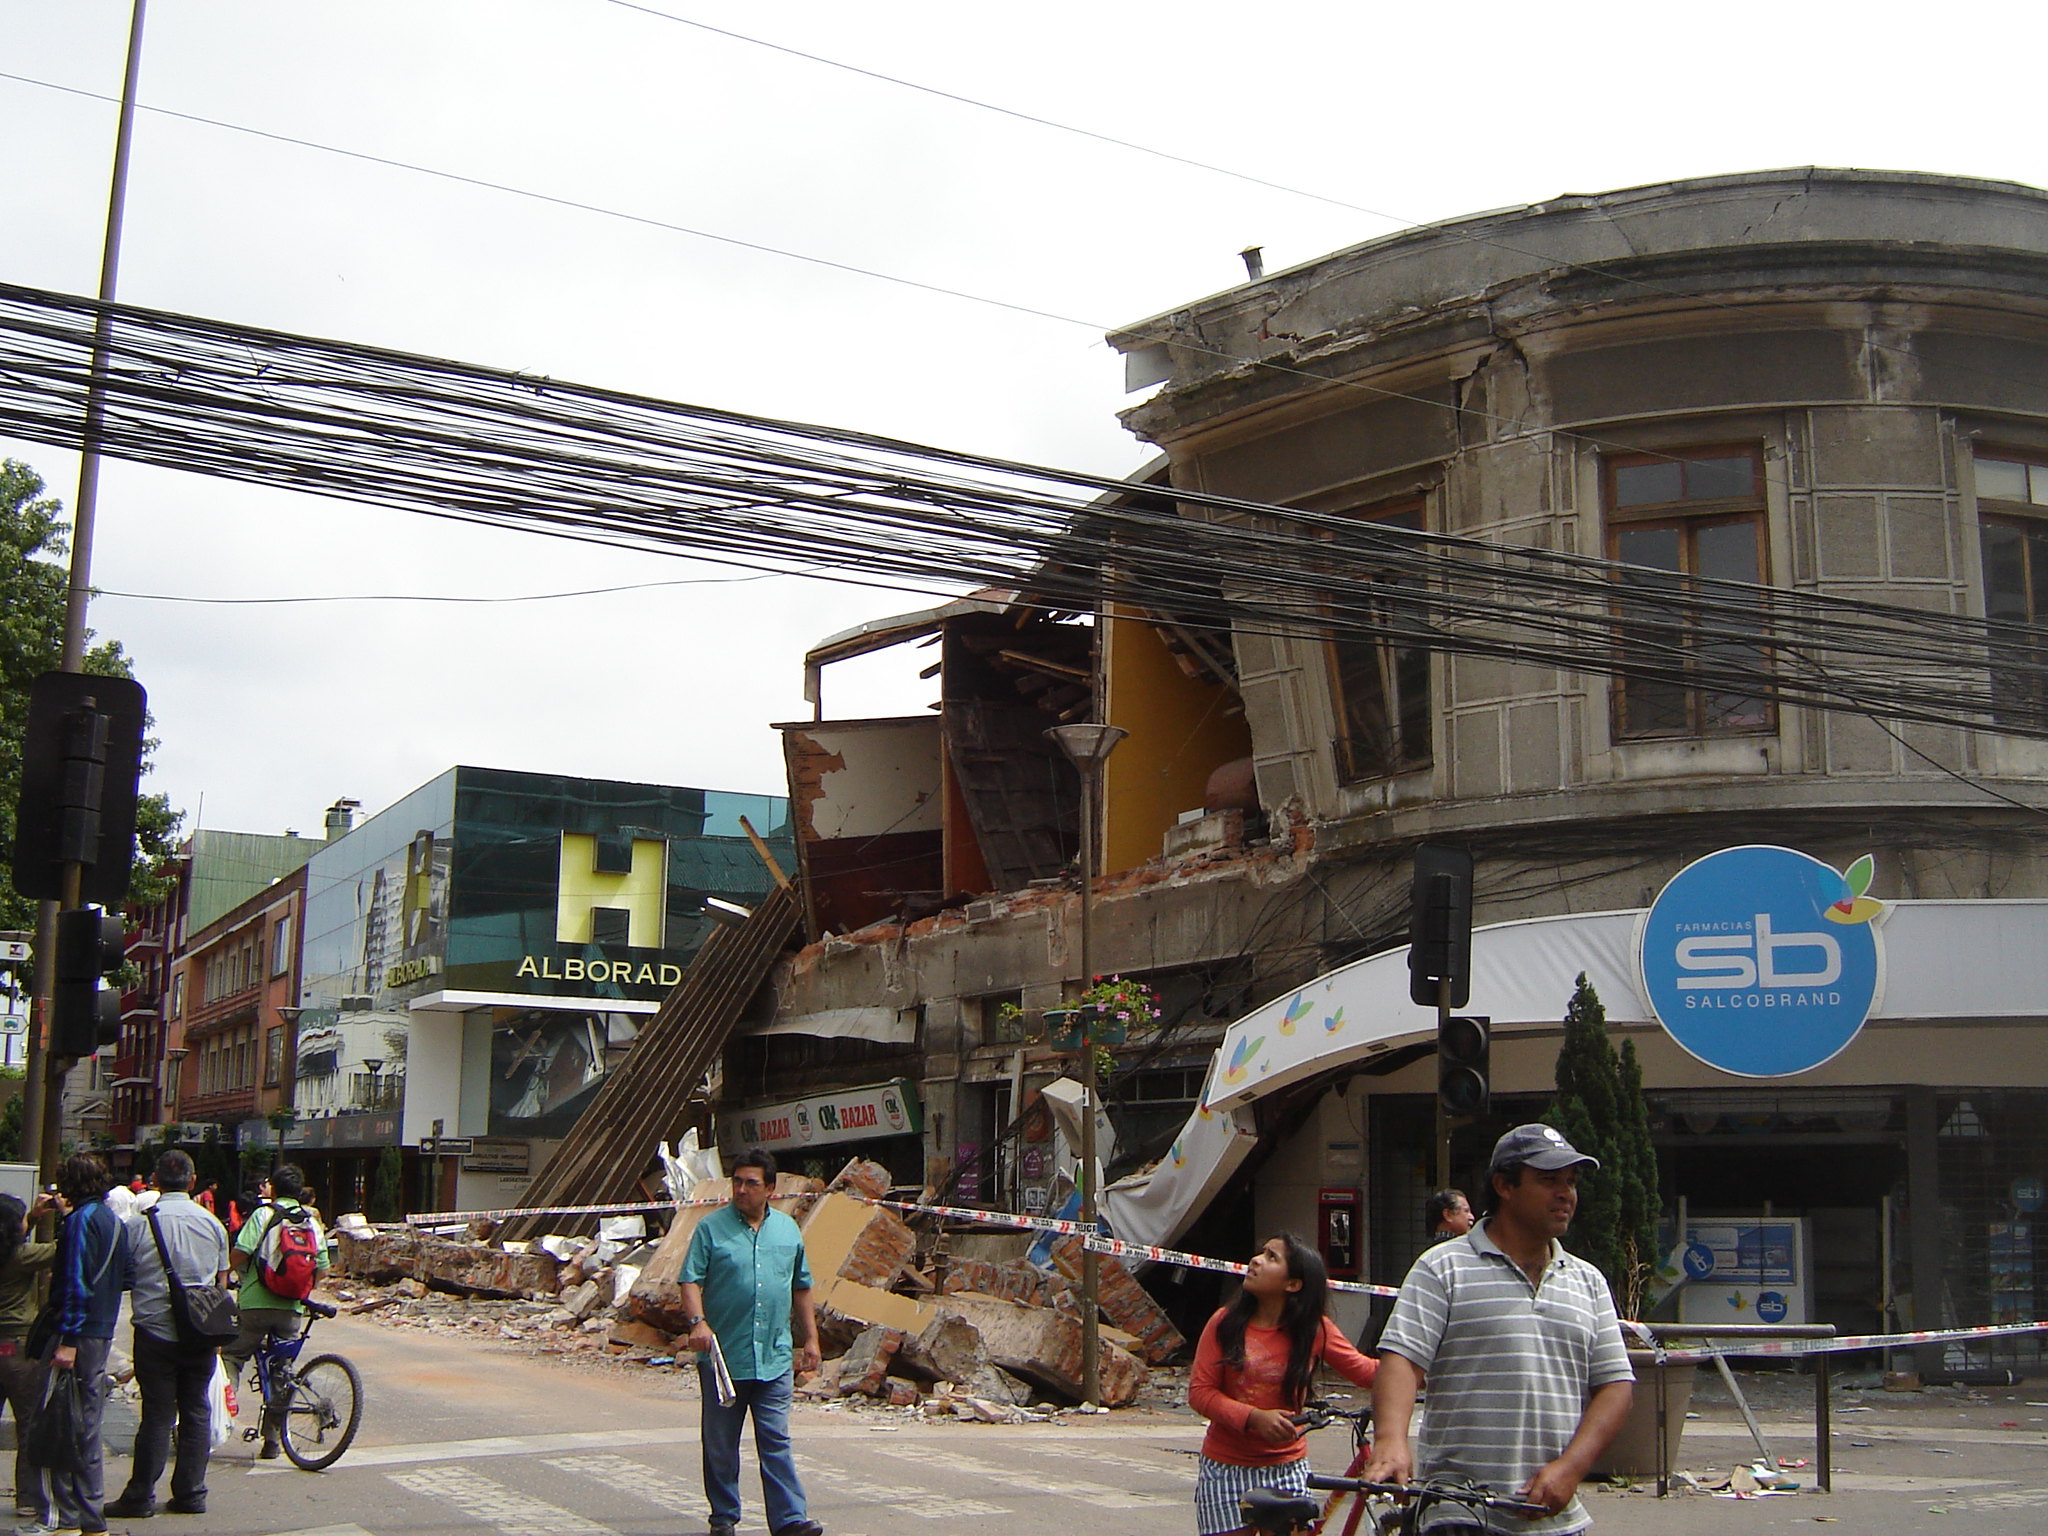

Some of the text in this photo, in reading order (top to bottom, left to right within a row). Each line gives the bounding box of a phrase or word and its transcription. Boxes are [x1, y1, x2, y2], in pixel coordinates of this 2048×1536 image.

[556, 829, 670, 949] H
[1675, 921, 1753, 933] FARMACIAS
[1675, 913, 1842, 990] sb
[516, 954, 682, 987] ALBORAD
[1685, 992, 1841, 1009] SALCOBRAND
[741, 1118, 759, 1143] OK
[760, 1117, 791, 1142] BAZAR
[818, 1104, 878, 1131] OK BAZAR
[1760, 1301, 1784, 1312] sb
